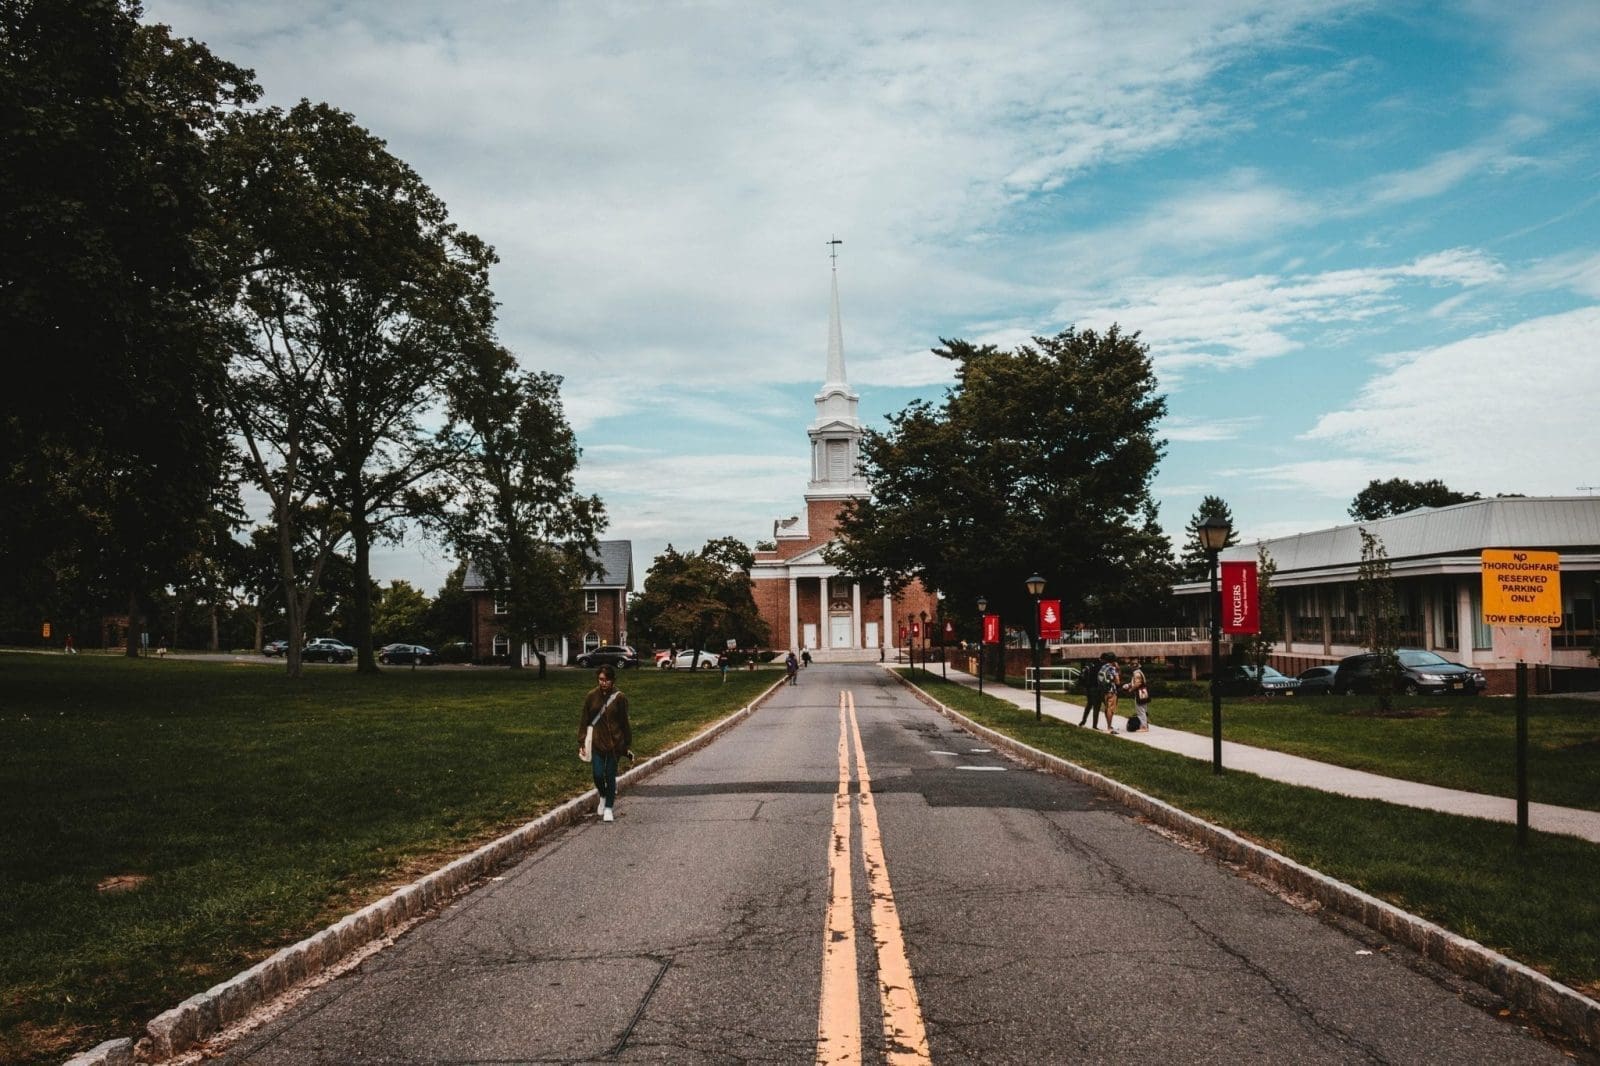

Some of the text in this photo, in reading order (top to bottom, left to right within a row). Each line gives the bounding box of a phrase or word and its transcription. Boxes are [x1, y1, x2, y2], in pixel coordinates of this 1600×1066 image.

[1513, 553, 1527, 561] NO
[1483, 562, 1560, 571] THOROUGHFARE
[1498, 575, 1547, 583] RESERVED
[1502, 584, 1544, 592] PARKING
[1233, 585, 1245, 626] RUTGERS
[1485, 614, 1561, 623] TOW ENFORCED
